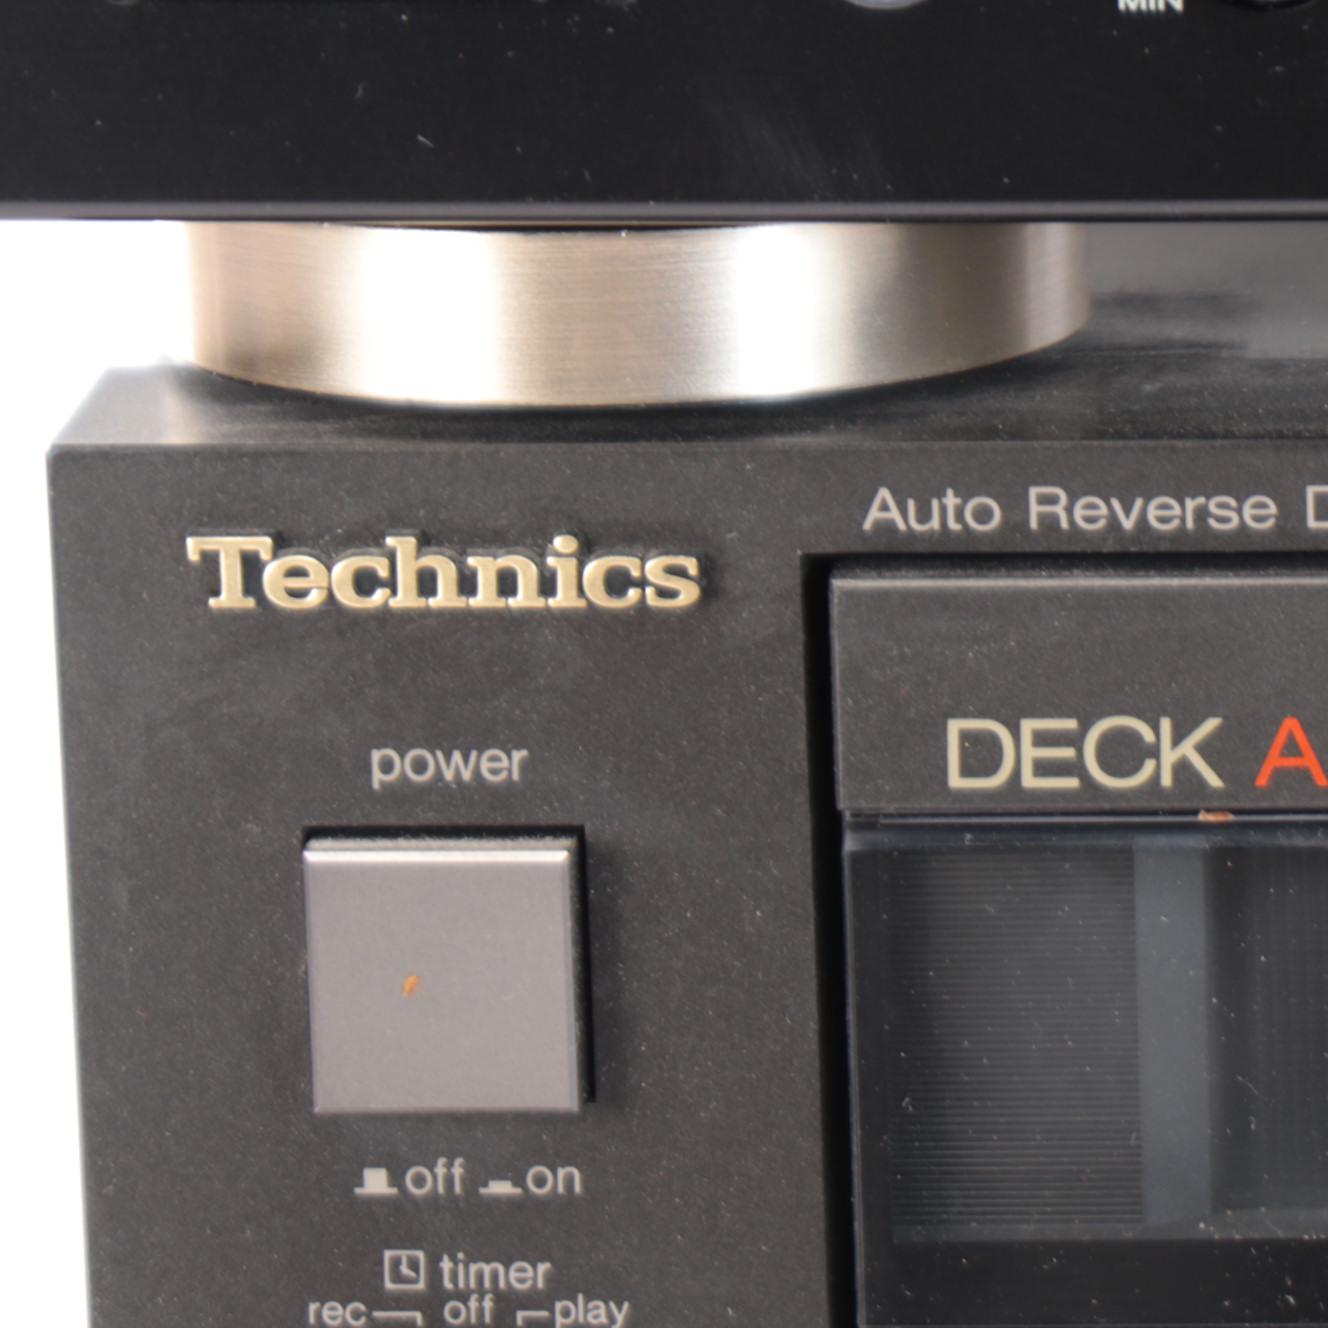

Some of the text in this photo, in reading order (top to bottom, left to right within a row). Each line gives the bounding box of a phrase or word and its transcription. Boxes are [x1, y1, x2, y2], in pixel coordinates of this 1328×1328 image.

[862, 486, 1003, 532] Auto
[1028, 486, 1278, 531] Reverse
[185, 534, 700, 611] Technics
[371, 748, 529, 790] power
[946, 715, 1225, 790] DECK
[1255, 716, 1328, 788] A
[405, 1157, 582, 1196] off on
[439, 1252, 552, 1291] timer
[308, 1301, 366, 1328] rec
[444, 1293, 494, 1325] off
